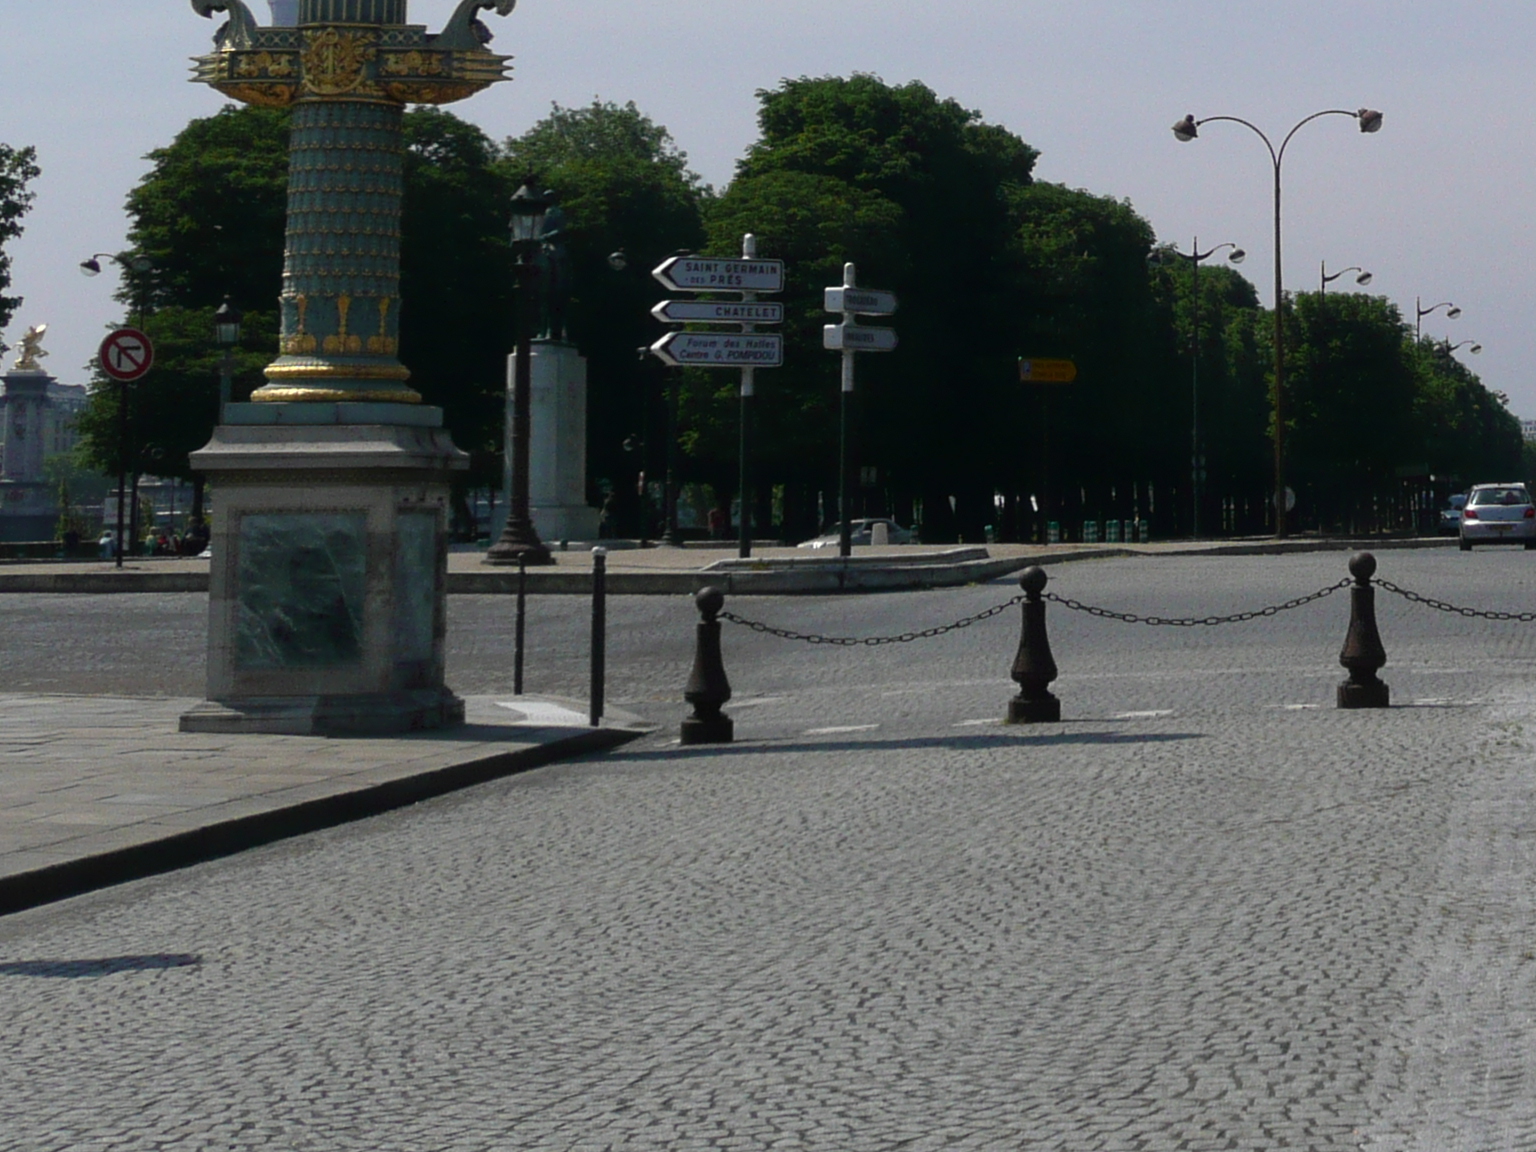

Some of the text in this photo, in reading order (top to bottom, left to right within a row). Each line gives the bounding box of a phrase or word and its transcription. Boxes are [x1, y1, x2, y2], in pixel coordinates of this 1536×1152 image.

[685, 262, 777, 274] SAINT GERMAIN
[715, 307, 777, 317] CHATELET
[687, 338, 776, 348] Forum des Halles
[679, 350, 709, 359] Centre
[727, 350, 776, 360] POMPIDOU
